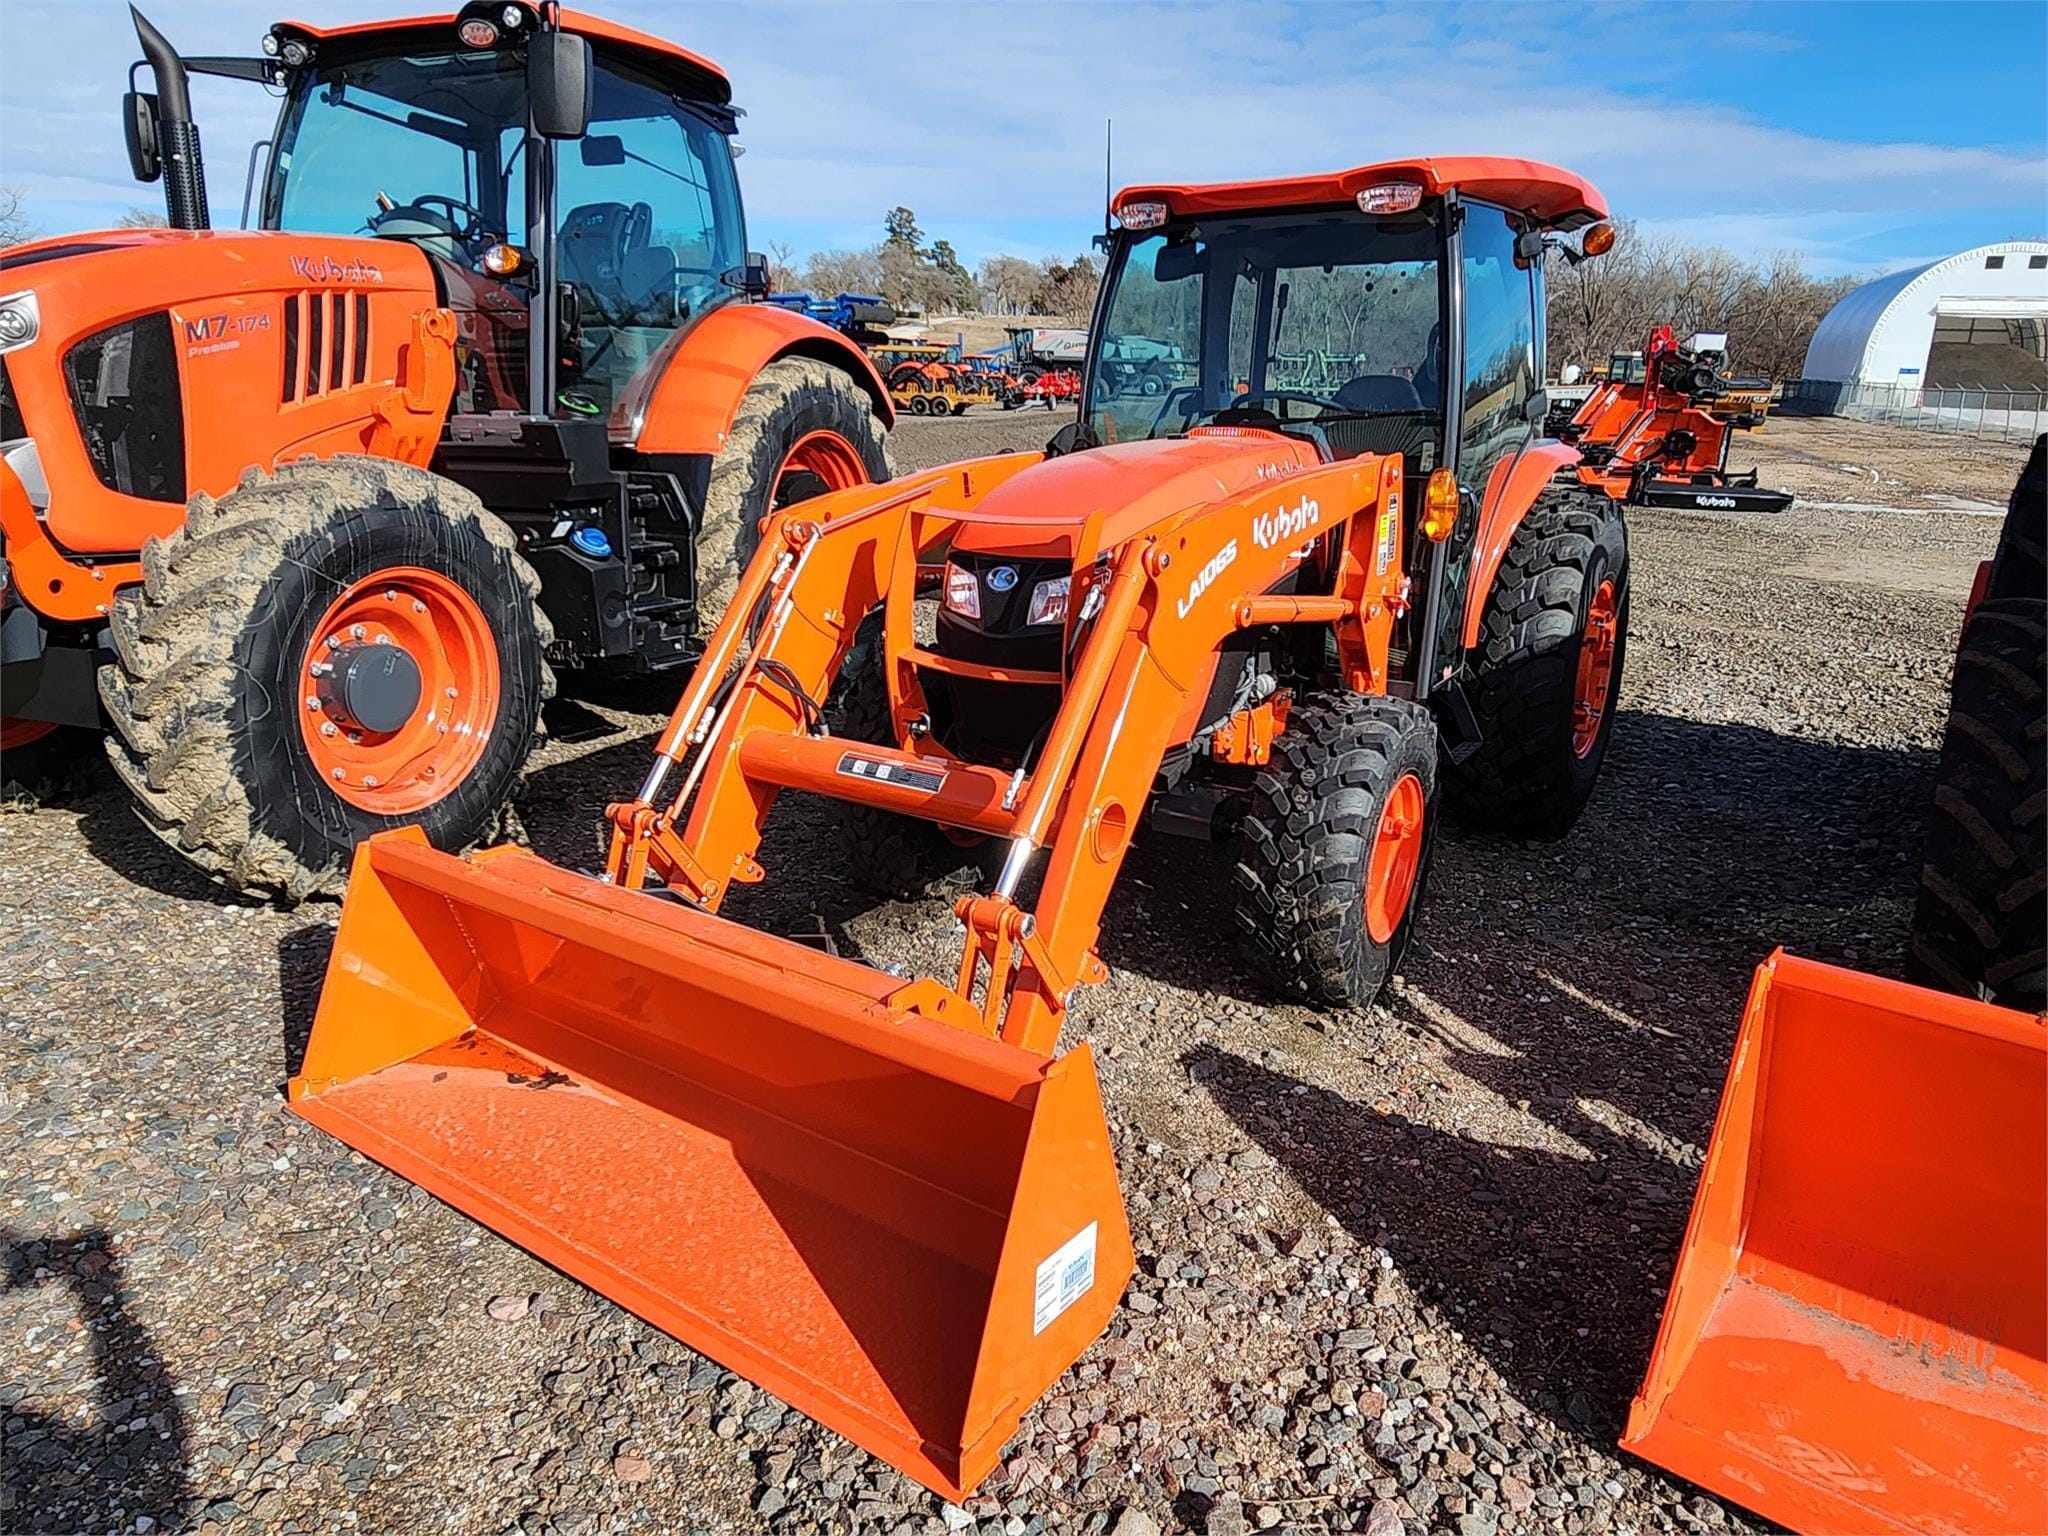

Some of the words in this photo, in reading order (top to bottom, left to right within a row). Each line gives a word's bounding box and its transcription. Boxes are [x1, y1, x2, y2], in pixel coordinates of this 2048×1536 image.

[290, 255, 382, 284] Kubota
[185, 314, 270, 343] M7-174
[188, 340, 240, 357] Premium
[1695, 495, 1737, 508] Kubota
[1253, 494, 1319, 549] Kubota
[1177, 537, 1238, 619] LA1065
